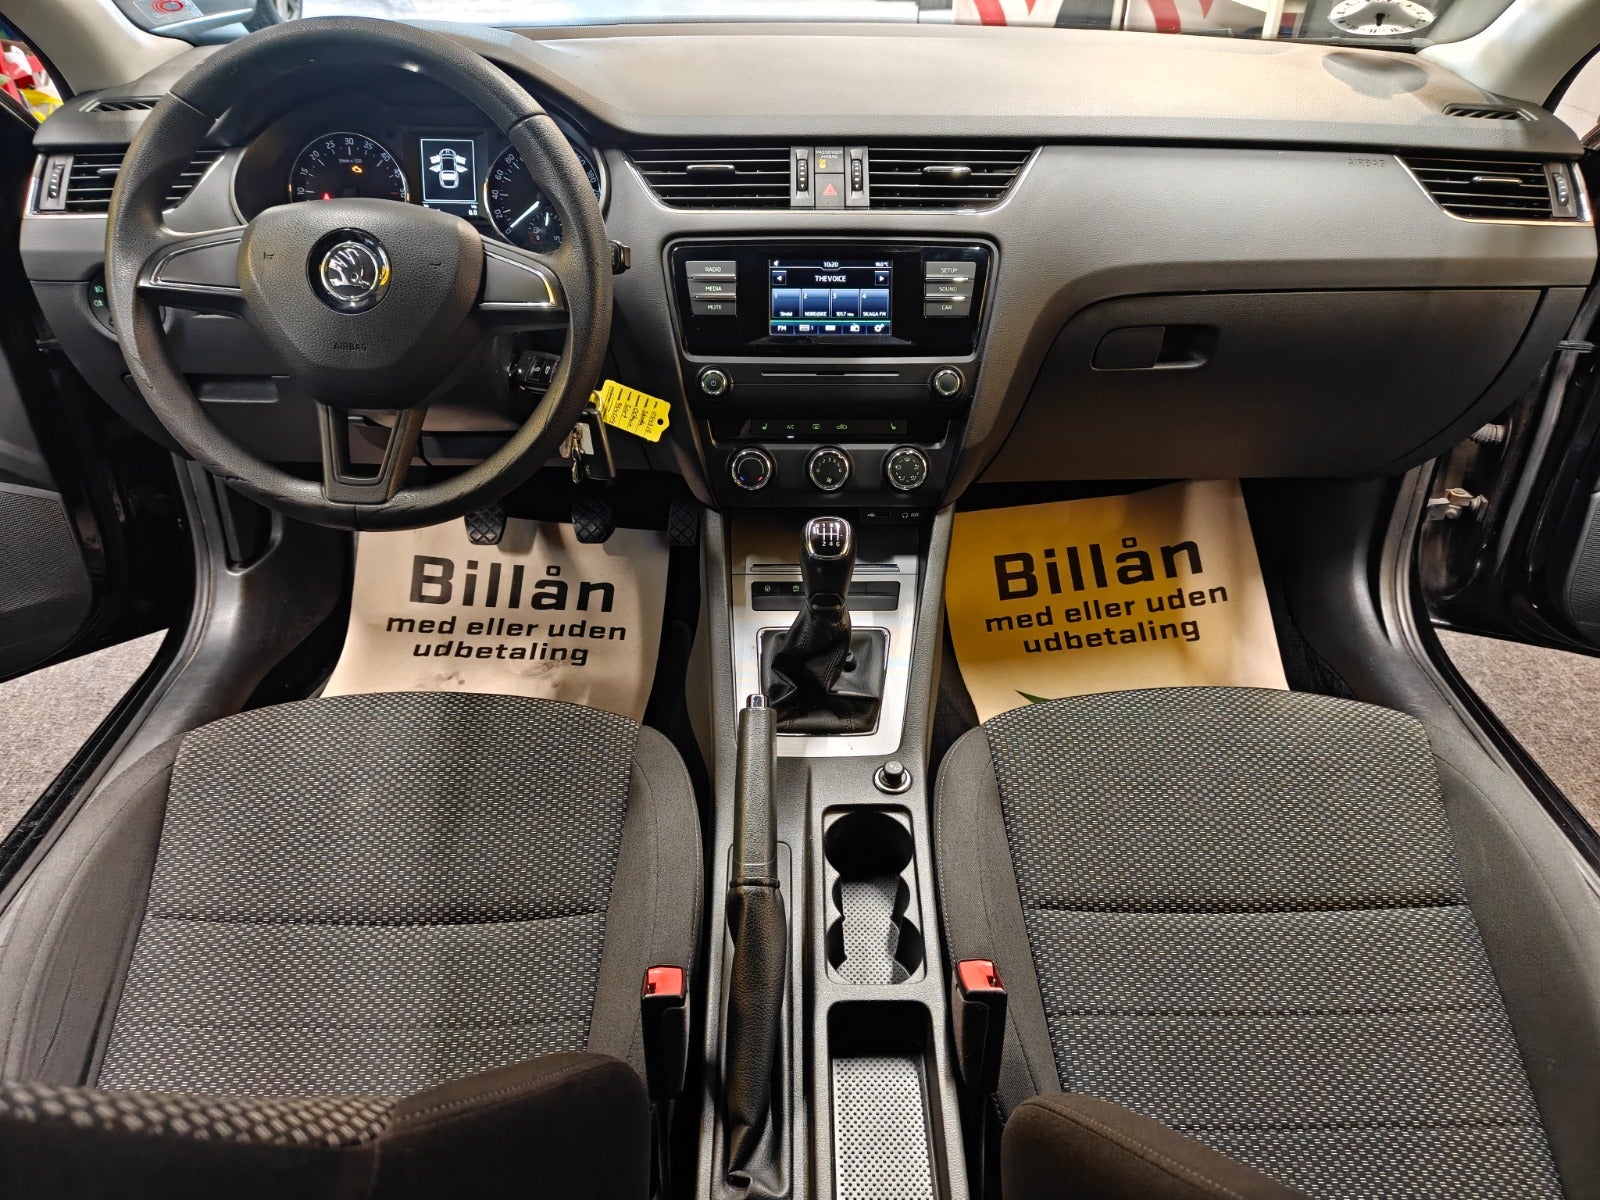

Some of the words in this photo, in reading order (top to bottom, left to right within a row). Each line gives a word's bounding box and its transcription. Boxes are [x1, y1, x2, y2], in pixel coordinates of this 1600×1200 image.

[325, 140, 336, 150] 25
[344, 137, 354, 146] 30
[363, 141, 374, 150] 35
[309, 150, 320, 161] 20
[380, 152, 391, 162] 40
[504, 153, 515, 165] 80
[494, 169, 504, 180] 60
[586, 169, 597, 183] 180
[297, 187, 305, 195] 10
[491, 189, 499, 200] 40
[494, 209, 504, 220] 20
[332, 342, 369, 351] AIRBAG
[993, 537, 1203, 602] Billån
[409, 554, 615, 613] Billån
[985, 605, 1054, 632] med
[1064, 599, 1135, 624] eller
[1146, 586, 1229, 614] uden
[386, 616, 457, 635] med
[466, 617, 539, 637] eller
[547, 620, 627, 641] uden
[1023, 620, 1201, 654] udbetaling
[413, 641, 589, 667] udbetaling
